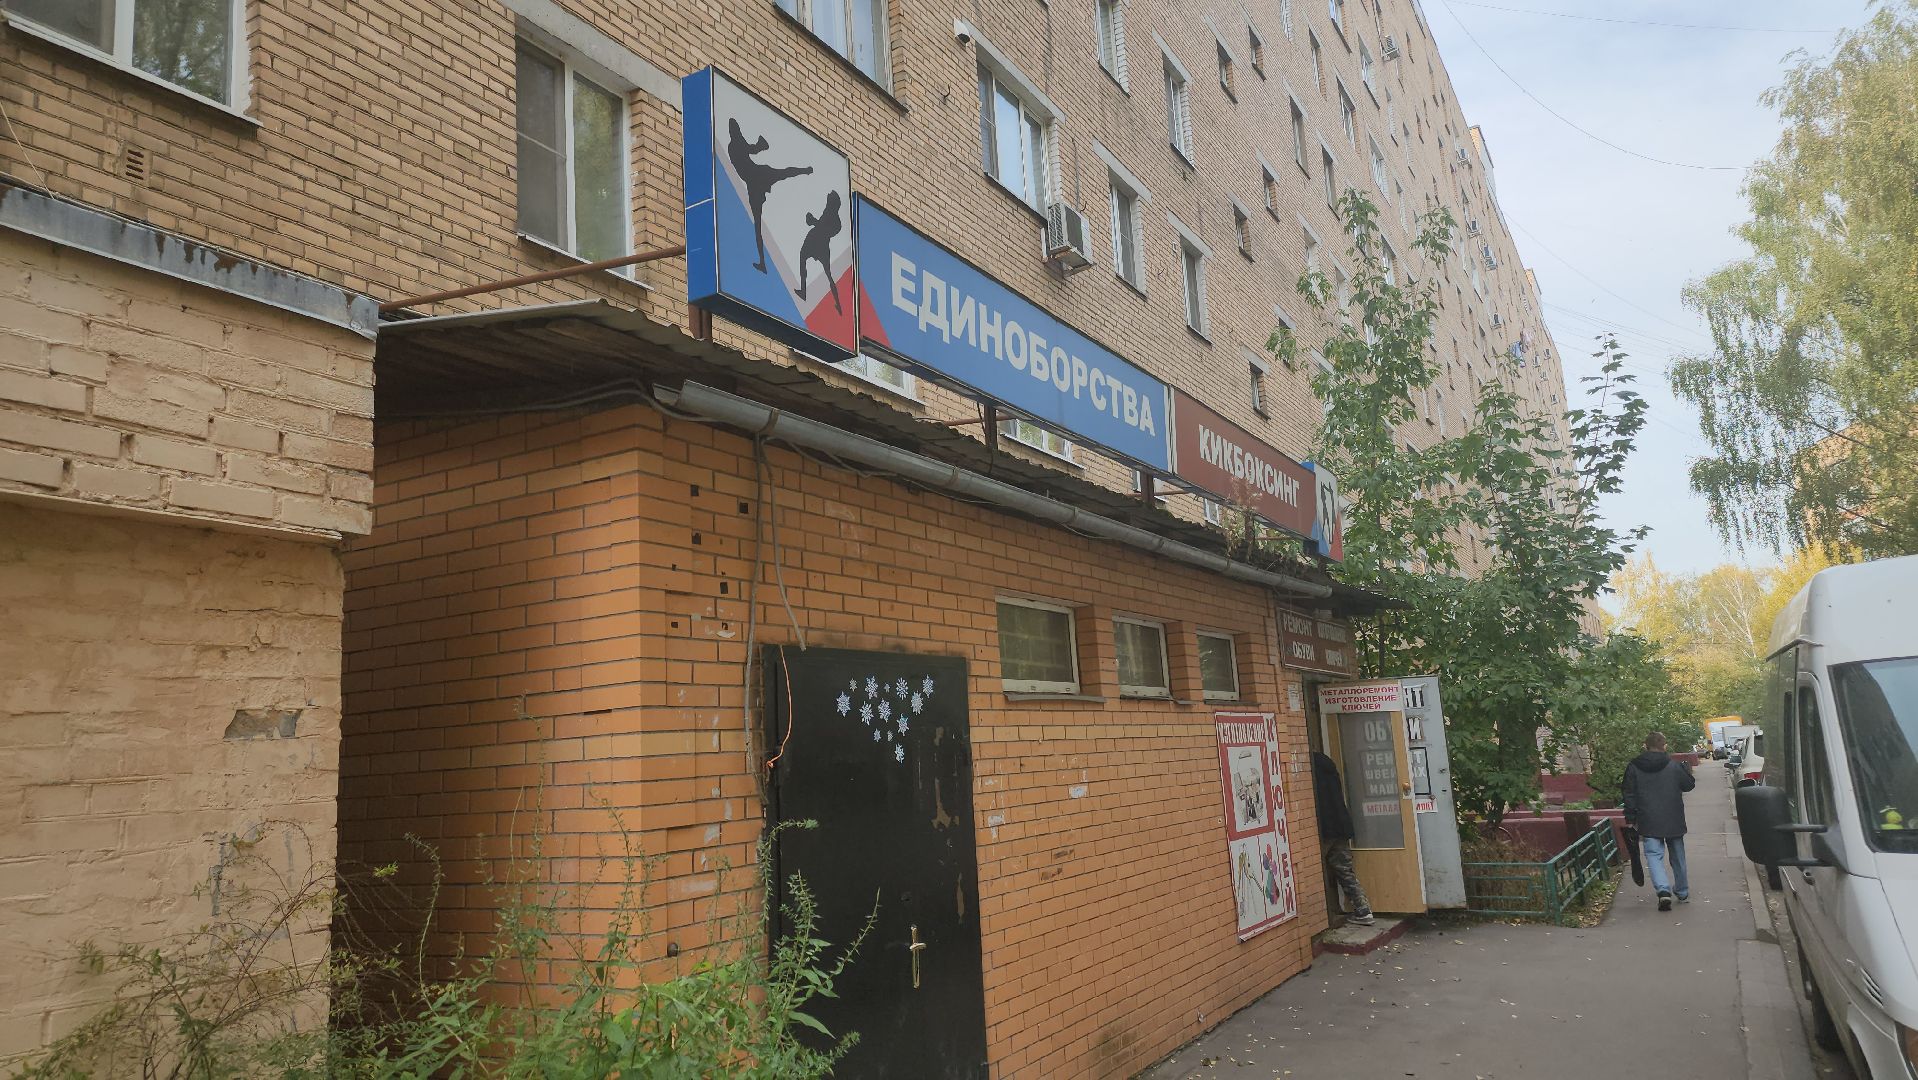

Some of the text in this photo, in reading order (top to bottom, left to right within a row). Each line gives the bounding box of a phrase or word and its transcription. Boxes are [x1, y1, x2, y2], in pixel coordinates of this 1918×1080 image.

[891, 252, 1156, 438] ЕДИНОБОРСТВА
[1199, 424, 1300, 508] КИКБОКСИНГ
[1283, 612, 1313, 637] РЕМОНТ
[1293, 640, 1315, 661] ОБУВИ
[1320, 686, 1399, 697] МЕТАЛЛОРЕМОНТ
[1325, 694, 1397, 705] ИЗГОТОВЛЕНИЕ
[1342, 703, 1381, 711] КЛЮЧЕЙ
